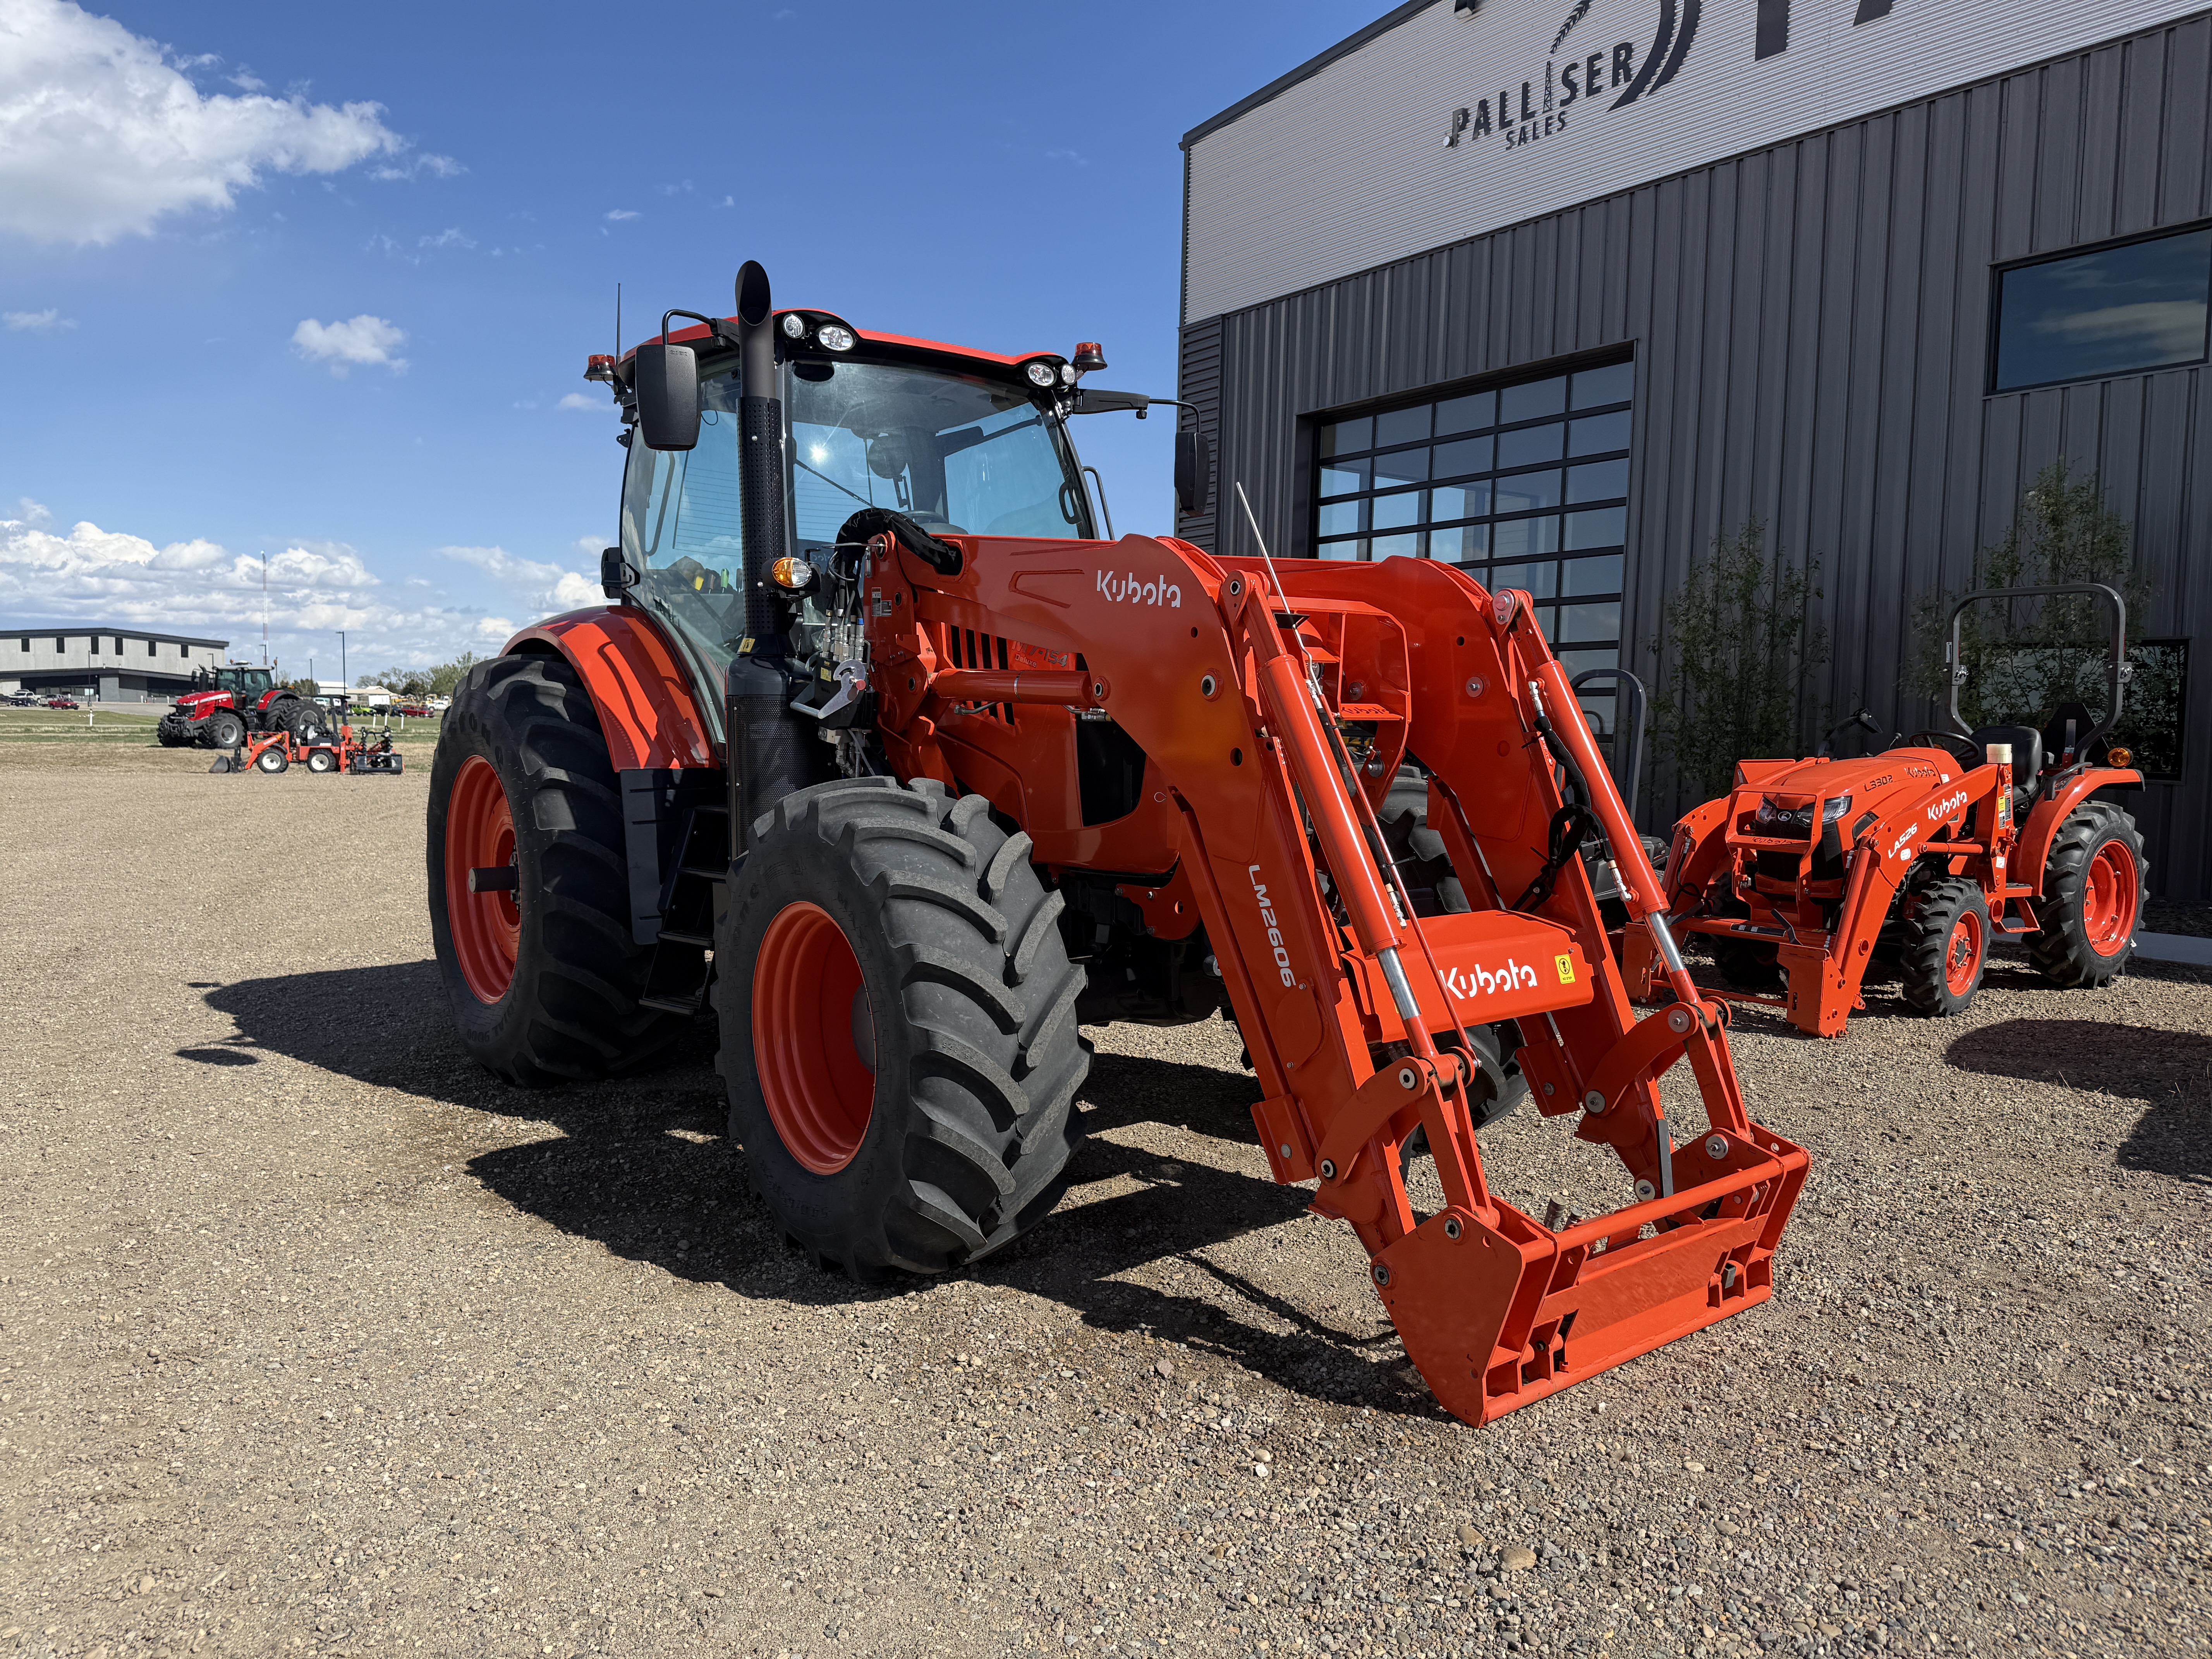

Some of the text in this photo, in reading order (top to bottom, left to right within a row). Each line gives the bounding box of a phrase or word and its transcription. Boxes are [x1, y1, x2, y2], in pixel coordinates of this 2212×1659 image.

[1506, 110, 1566, 150] SALES
[1097, 570, 1181, 608] Kubota
[1015, 653, 1037, 668] Deluxe
[1863, 775, 1893, 792] L3302
[1904, 766, 1936, 778] Kubota
[1927, 790, 1968, 821] Kubota
[1887, 822, 1917, 859] LA526
[1249, 864, 1297, 987] LM2606
[1439, 958, 1537, 1000] Kubota
[466, 1026, 490, 1043] 9000
